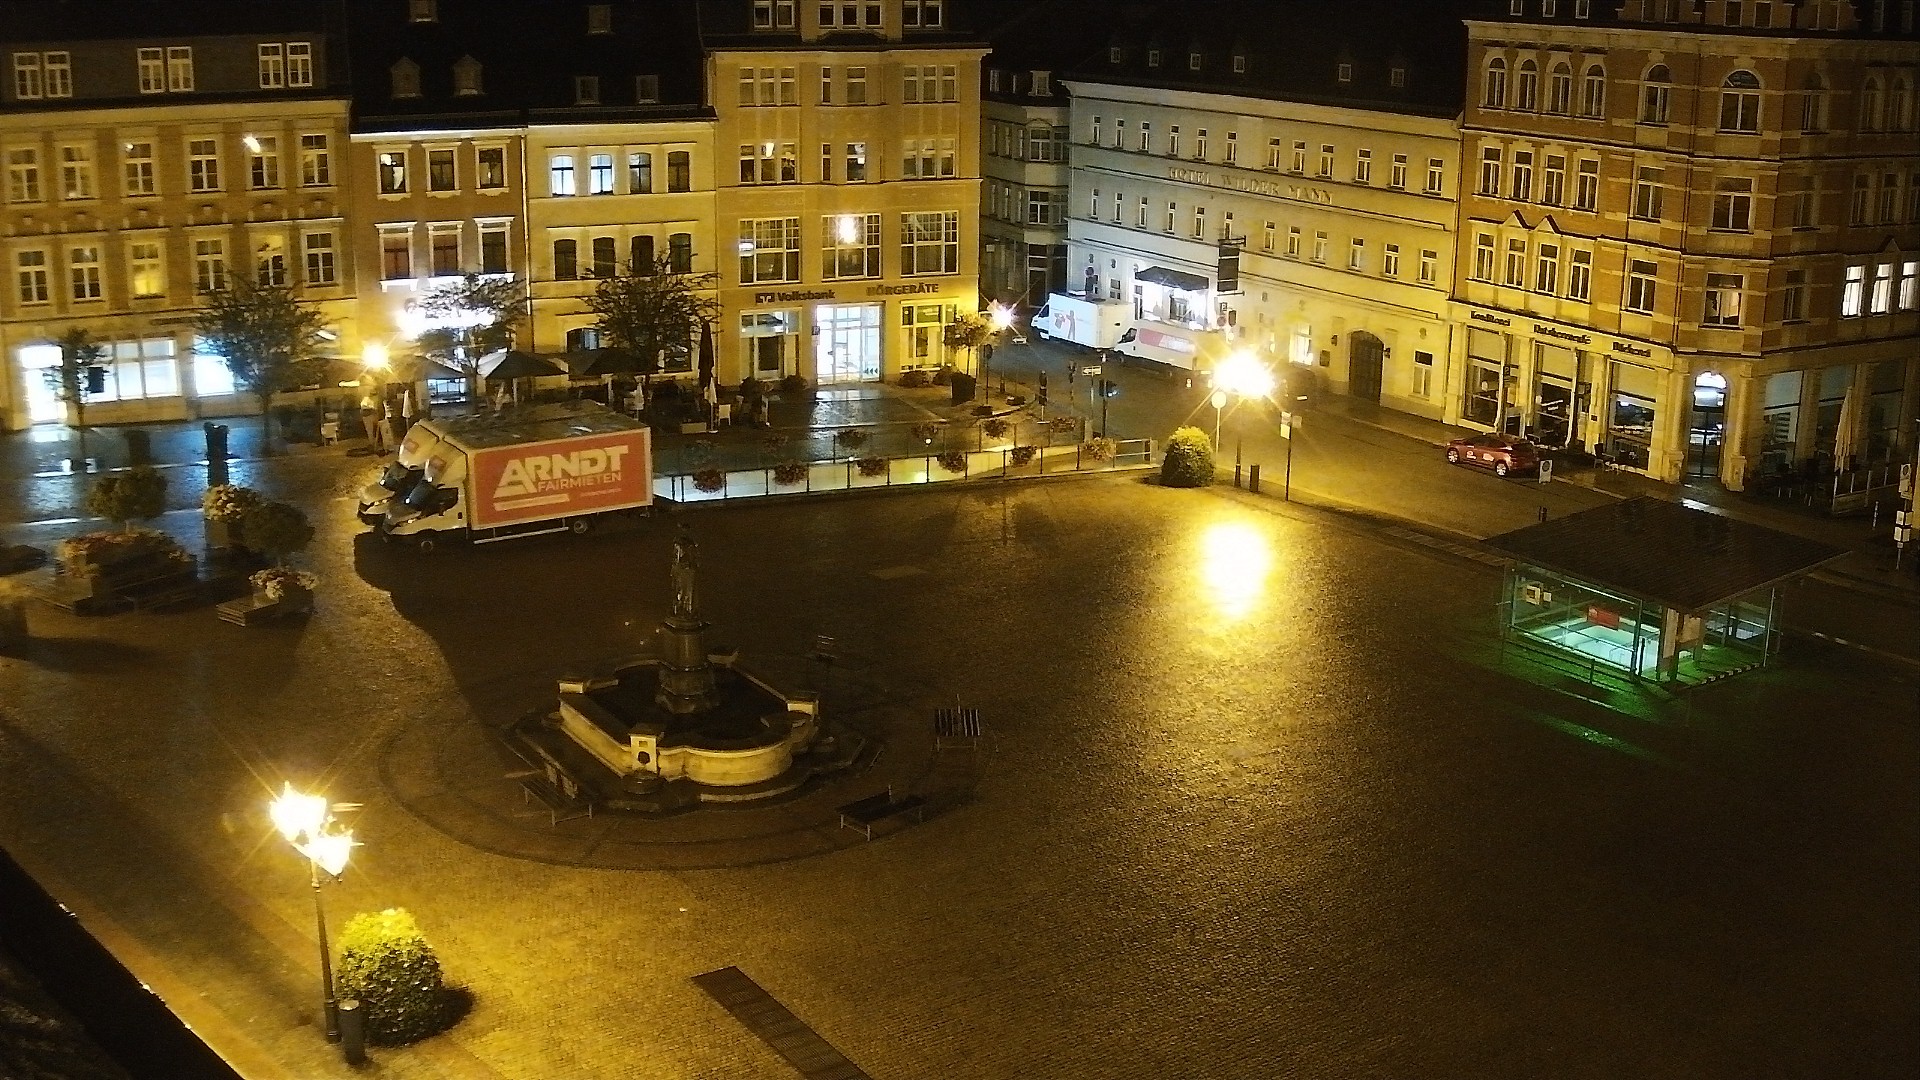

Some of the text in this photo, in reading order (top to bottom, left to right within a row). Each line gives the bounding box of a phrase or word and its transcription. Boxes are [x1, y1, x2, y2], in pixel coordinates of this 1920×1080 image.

[1168, 166, 1334, 205] HOTEL WILDER MANN
[777, 289, 836, 301] Volksbank
[866, 282, 939, 297] HÖRGERÄTE
[493, 445, 629, 499] ARNDT
[537, 472, 622, 493] FAIRMIETEN
